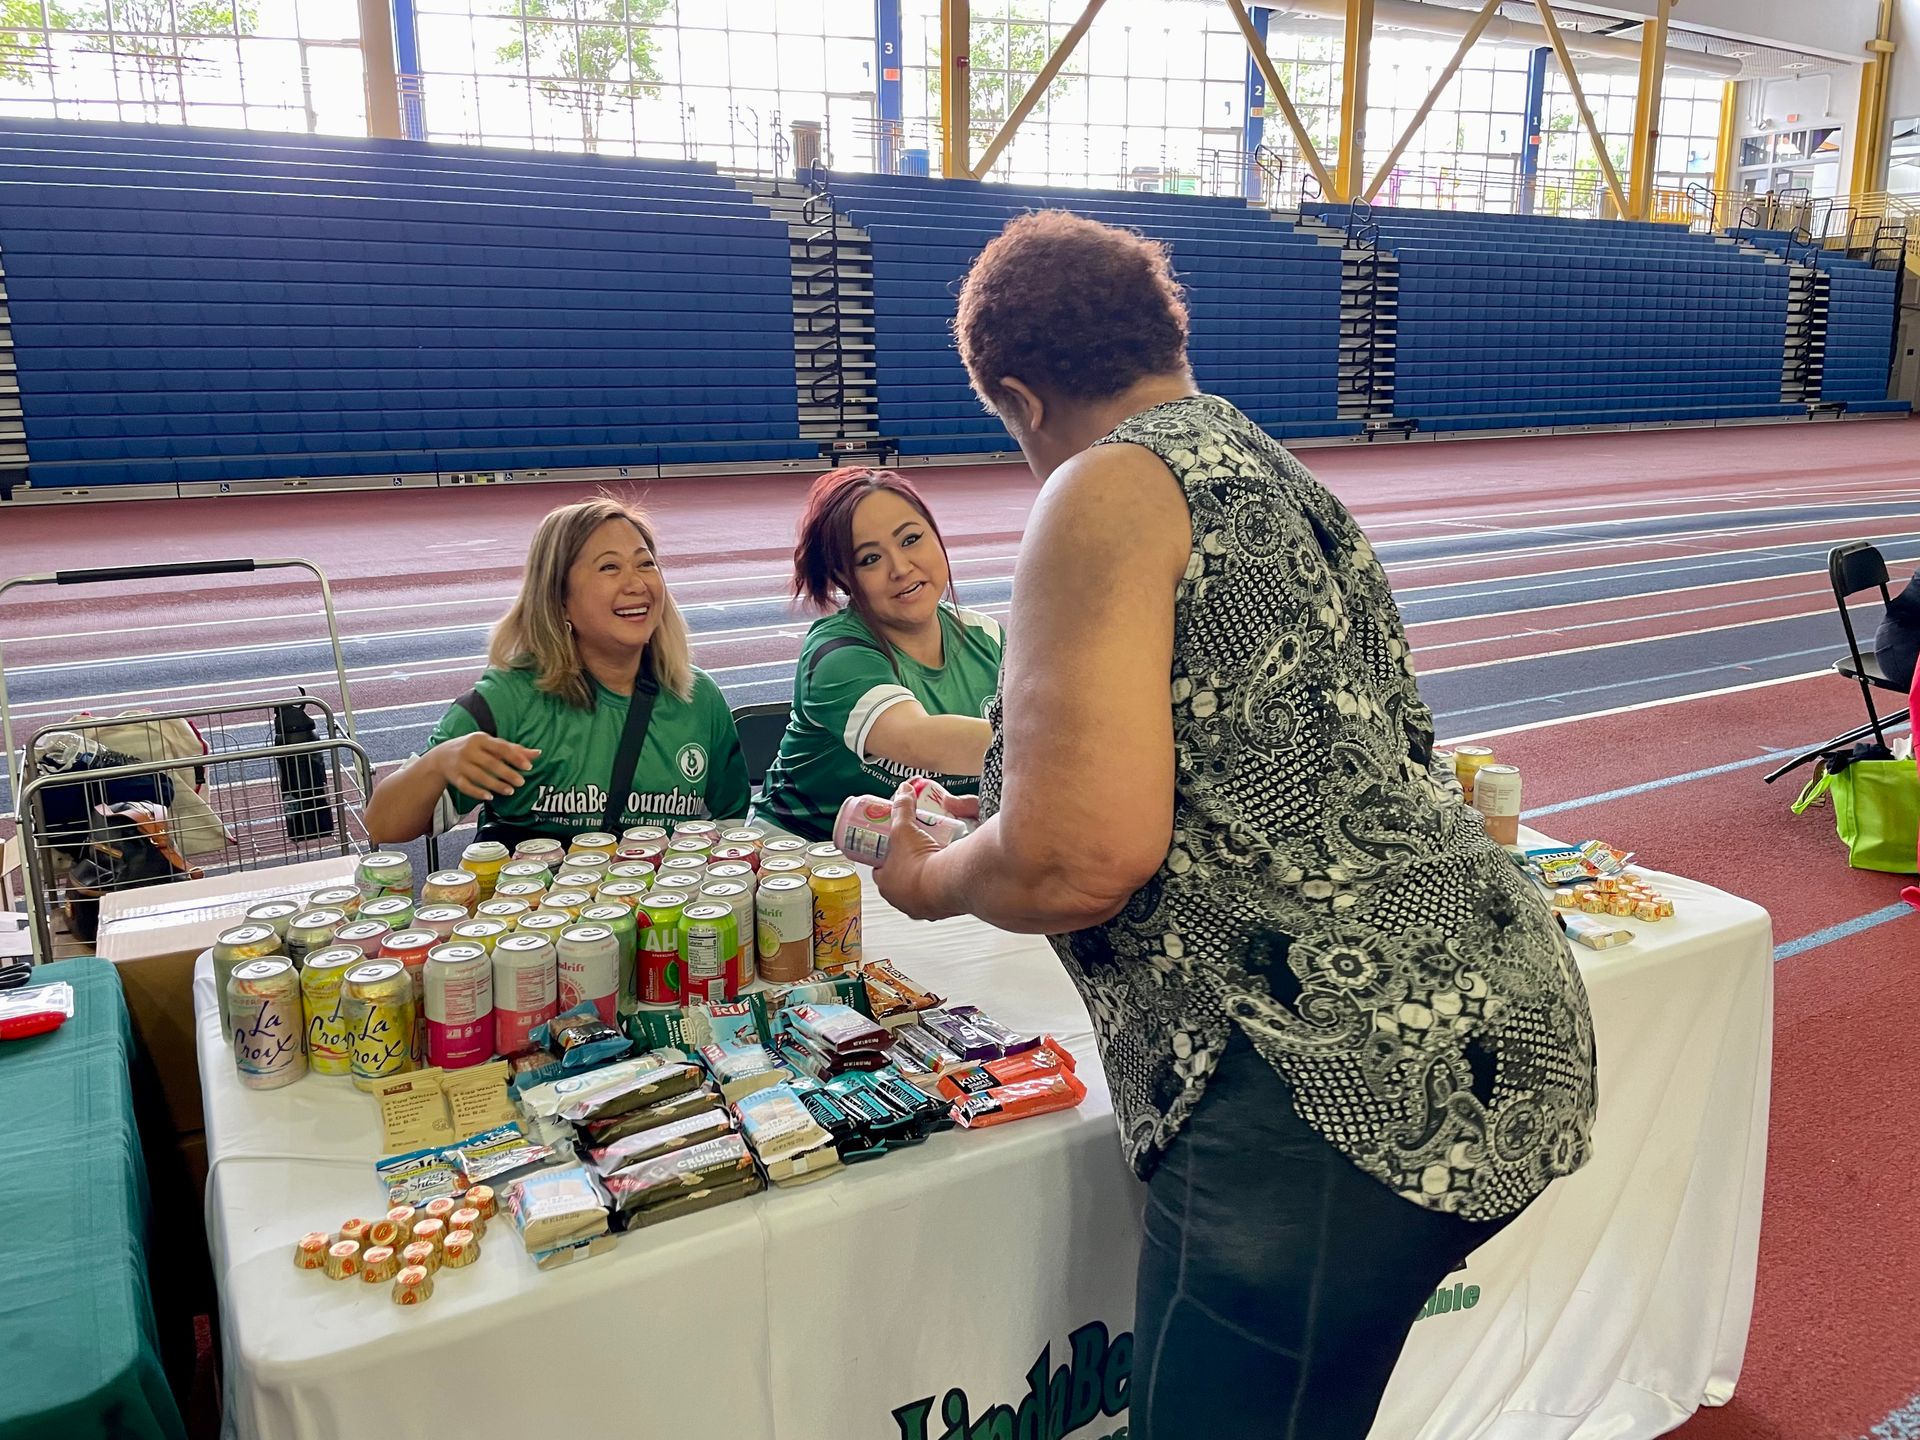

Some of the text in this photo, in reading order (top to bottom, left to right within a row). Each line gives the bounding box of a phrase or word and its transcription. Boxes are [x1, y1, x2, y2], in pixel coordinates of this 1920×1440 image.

[884, 42, 894, 54] 3
[1254, 85, 1263, 96] 2
[1532, 116, 1539, 126] 1
[530, 784, 608, 813] LindaBe
[646, 929, 678, 952] AH
[248, 1000, 282, 1037] La
[359, 1005, 391, 1043] La
[234, 1028, 296, 1066] Croix
[959, 1072, 989, 1088] KIND
[676, 1144, 742, 1169] CRUNCHY
[690, 1140, 723, 1154] KODIAK
